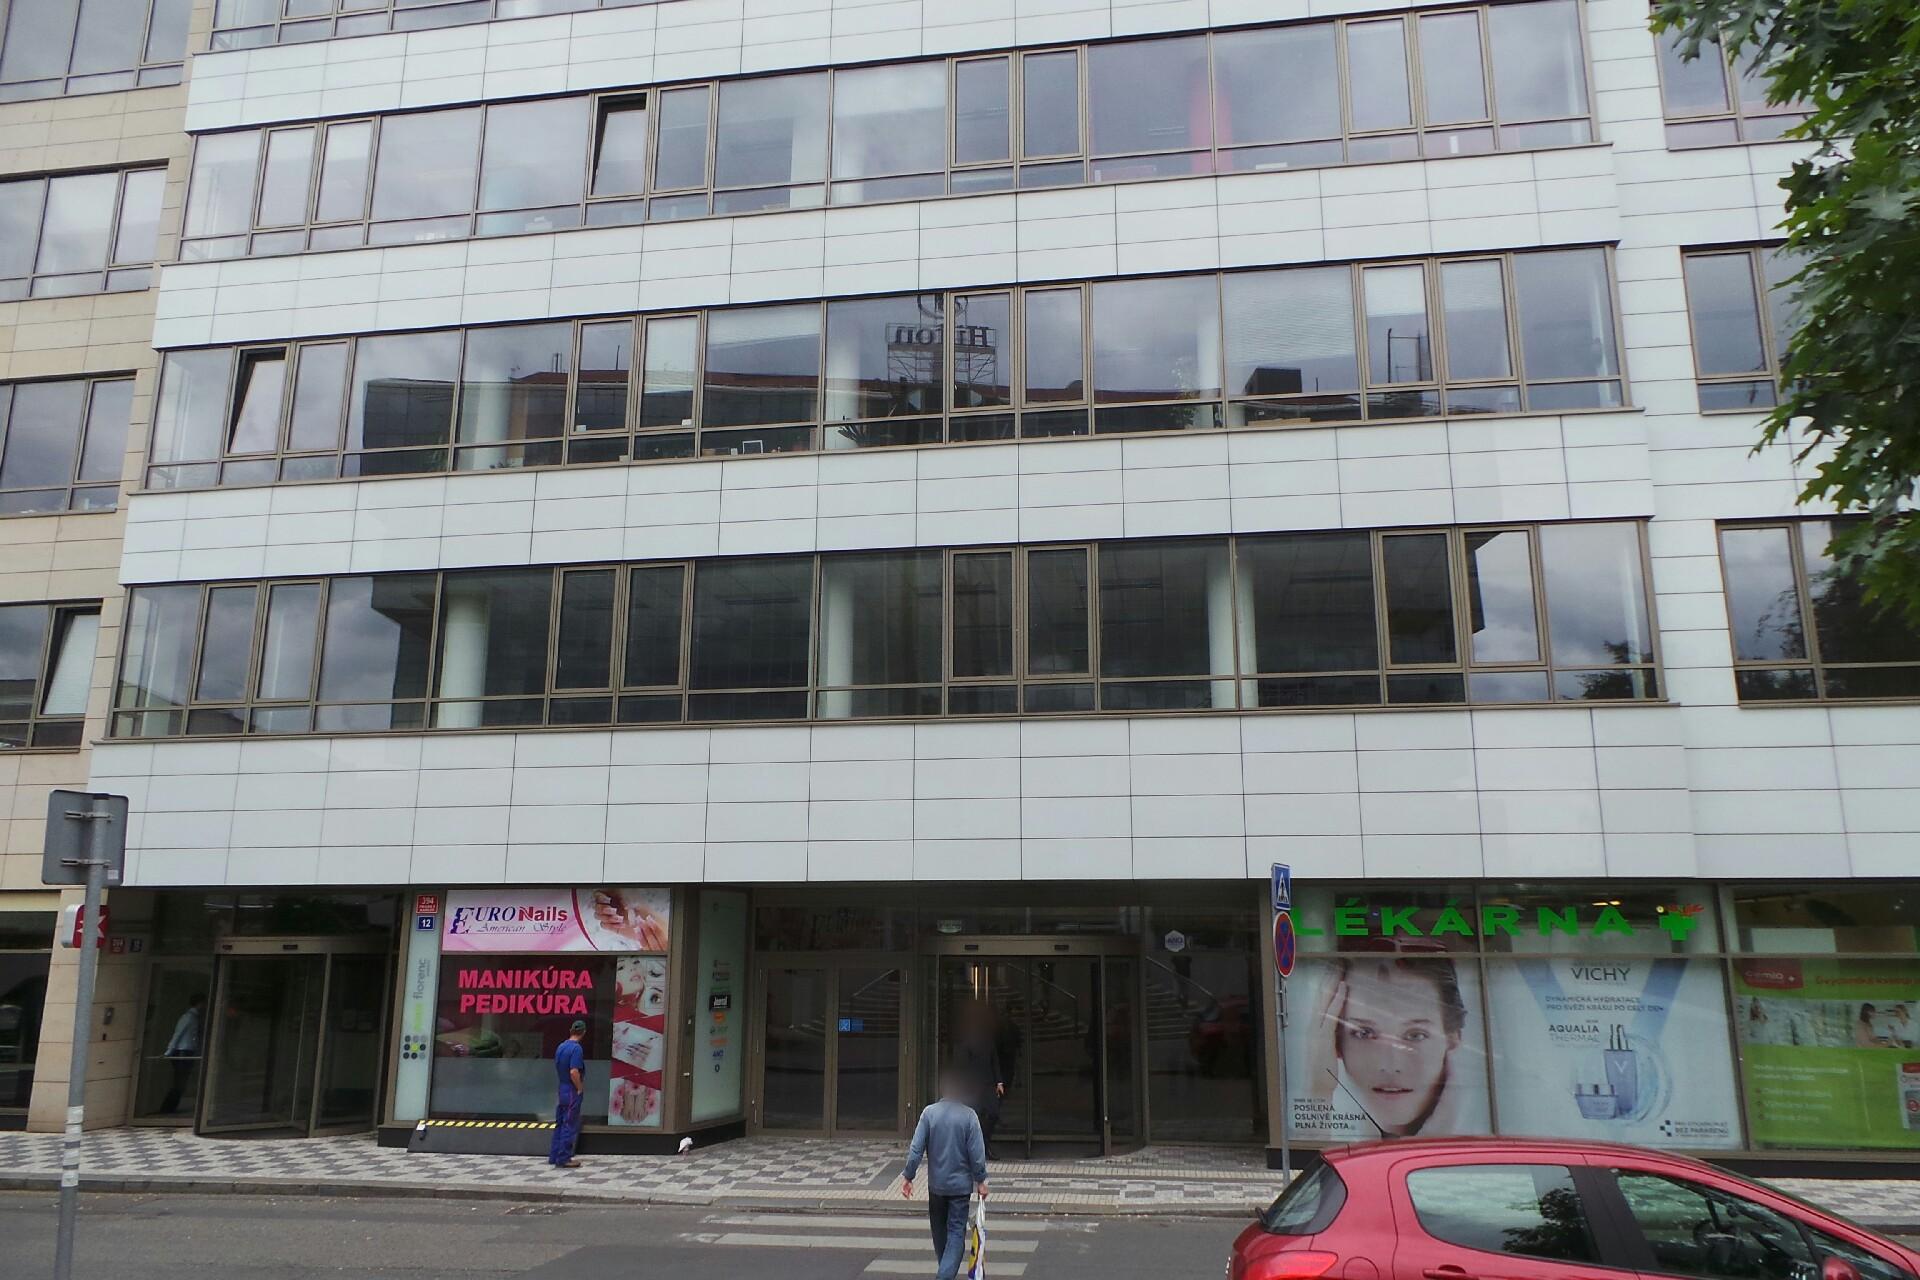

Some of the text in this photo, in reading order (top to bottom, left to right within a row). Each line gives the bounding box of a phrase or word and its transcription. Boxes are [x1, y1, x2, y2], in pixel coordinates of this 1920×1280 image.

[421, 919, 431, 928] 12
[450, 906, 568, 935] EURO Nails
[1292, 898, 1634, 936] LÉKÁRNA
[477, 922, 526, 933] American
[459, 965, 593, 989] MANIKÚRA
[1571, 967, 1631, 981] VICHY
[460, 990, 588, 1015] PEDIKÚRA
[1548, 1024, 1600, 1033] AQUALIA
